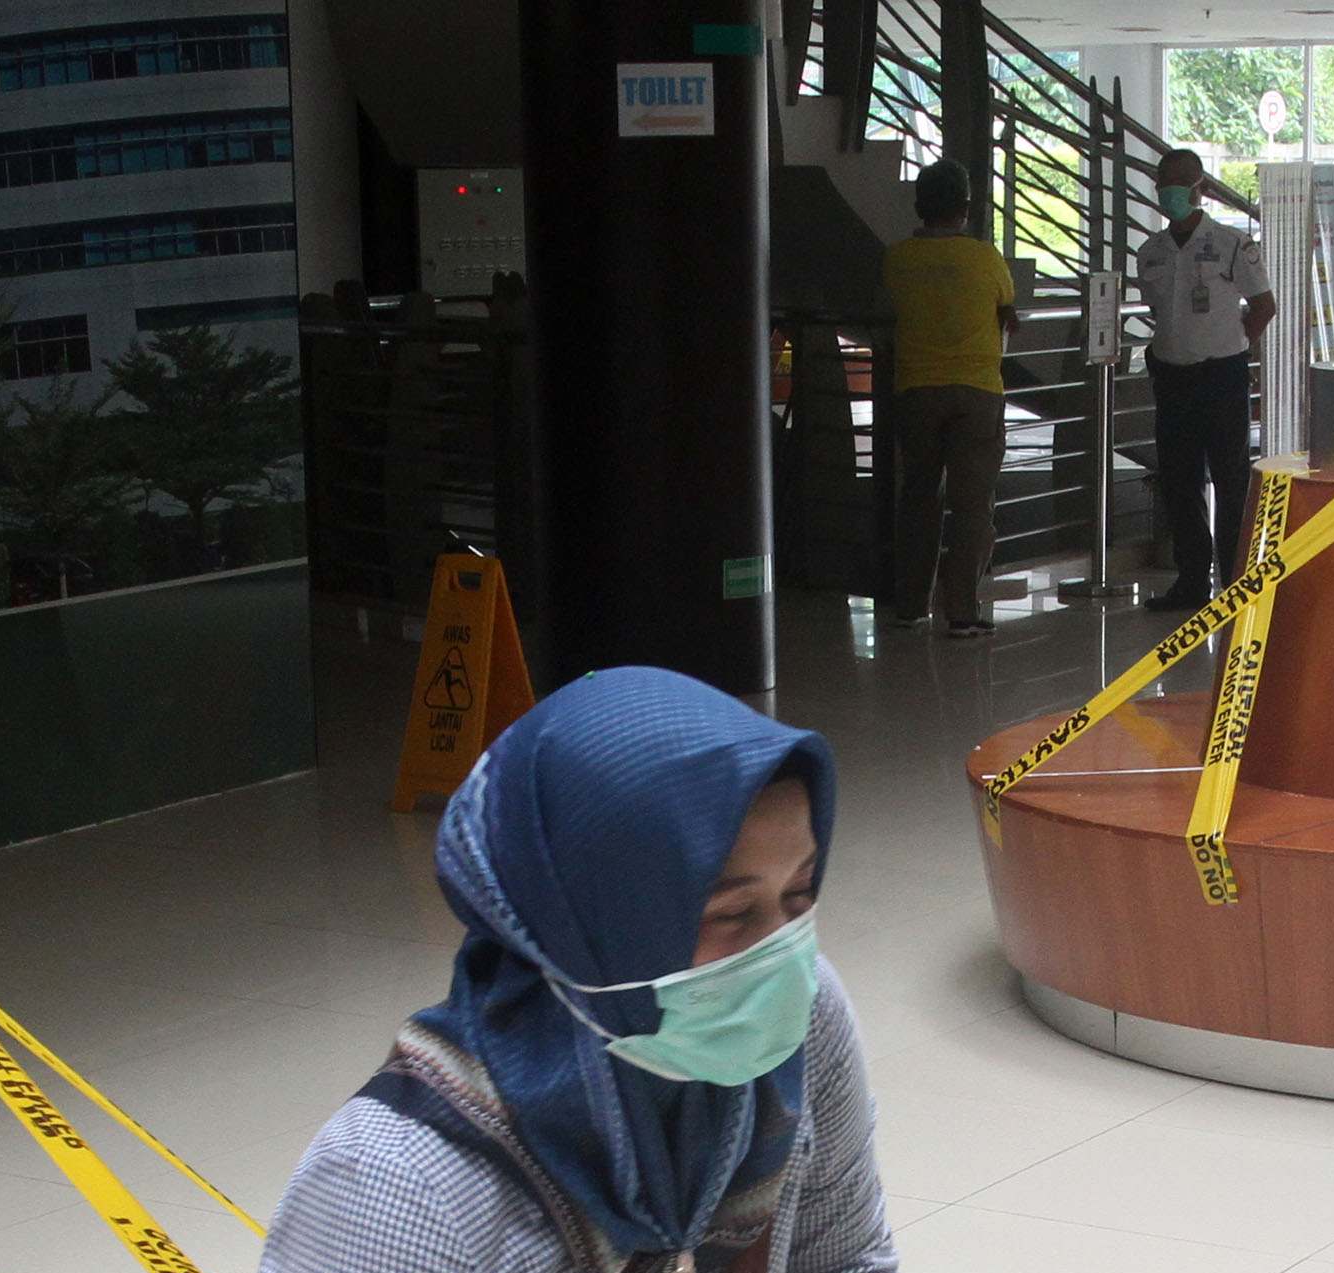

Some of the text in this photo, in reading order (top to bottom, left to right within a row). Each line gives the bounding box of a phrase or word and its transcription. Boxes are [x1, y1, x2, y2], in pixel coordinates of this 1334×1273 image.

[621, 76, 707, 106] TOILET
[443, 625, 472, 643] AWAS
[1207, 646, 1243, 765] DO NOT ENTER
[429, 712, 462, 731] LANTAI
[430, 736, 456, 752] LICIN
[1191, 833, 1211, 865] DO
